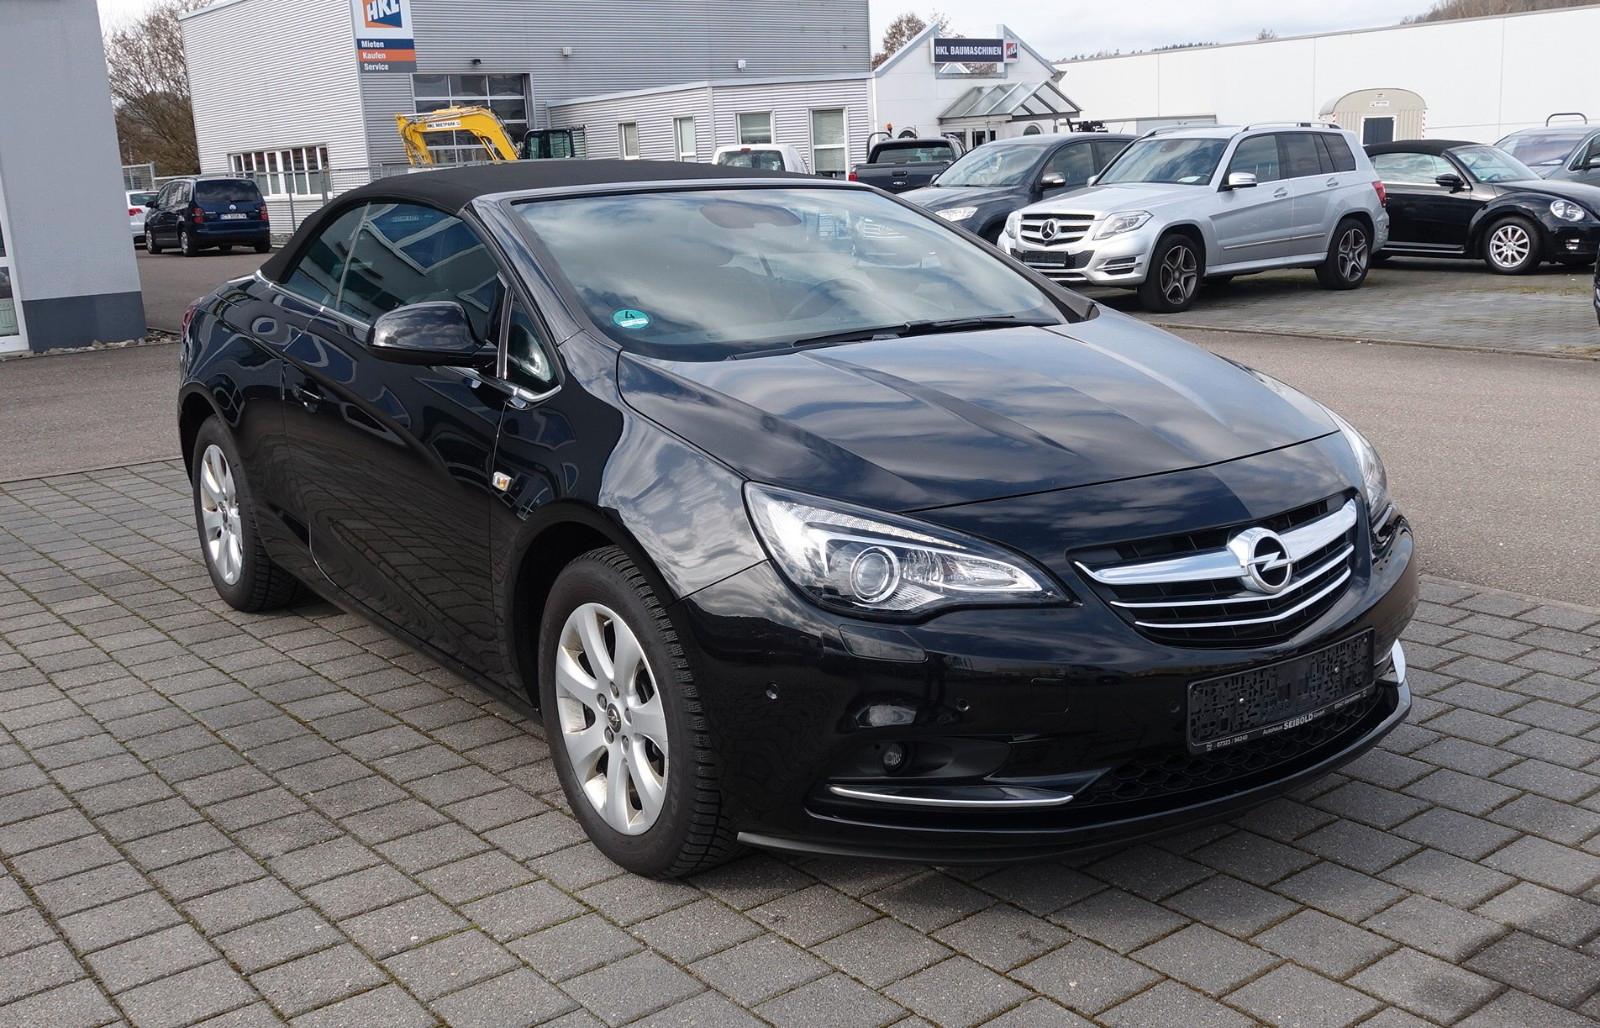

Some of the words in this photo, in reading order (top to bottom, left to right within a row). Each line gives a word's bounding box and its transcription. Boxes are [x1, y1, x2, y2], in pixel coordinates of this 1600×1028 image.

[367, 0, 400, 21] HKL
[361, 40, 384, 48] Mieten
[935, 46, 949, 55] HKL
[950, 46, 1001, 55] BAUMASCHINEN
[362, 51, 386, 59] Kaufen
[364, 63, 389, 71] Service
[1283, 713, 1314, 730] SEIBOLD
